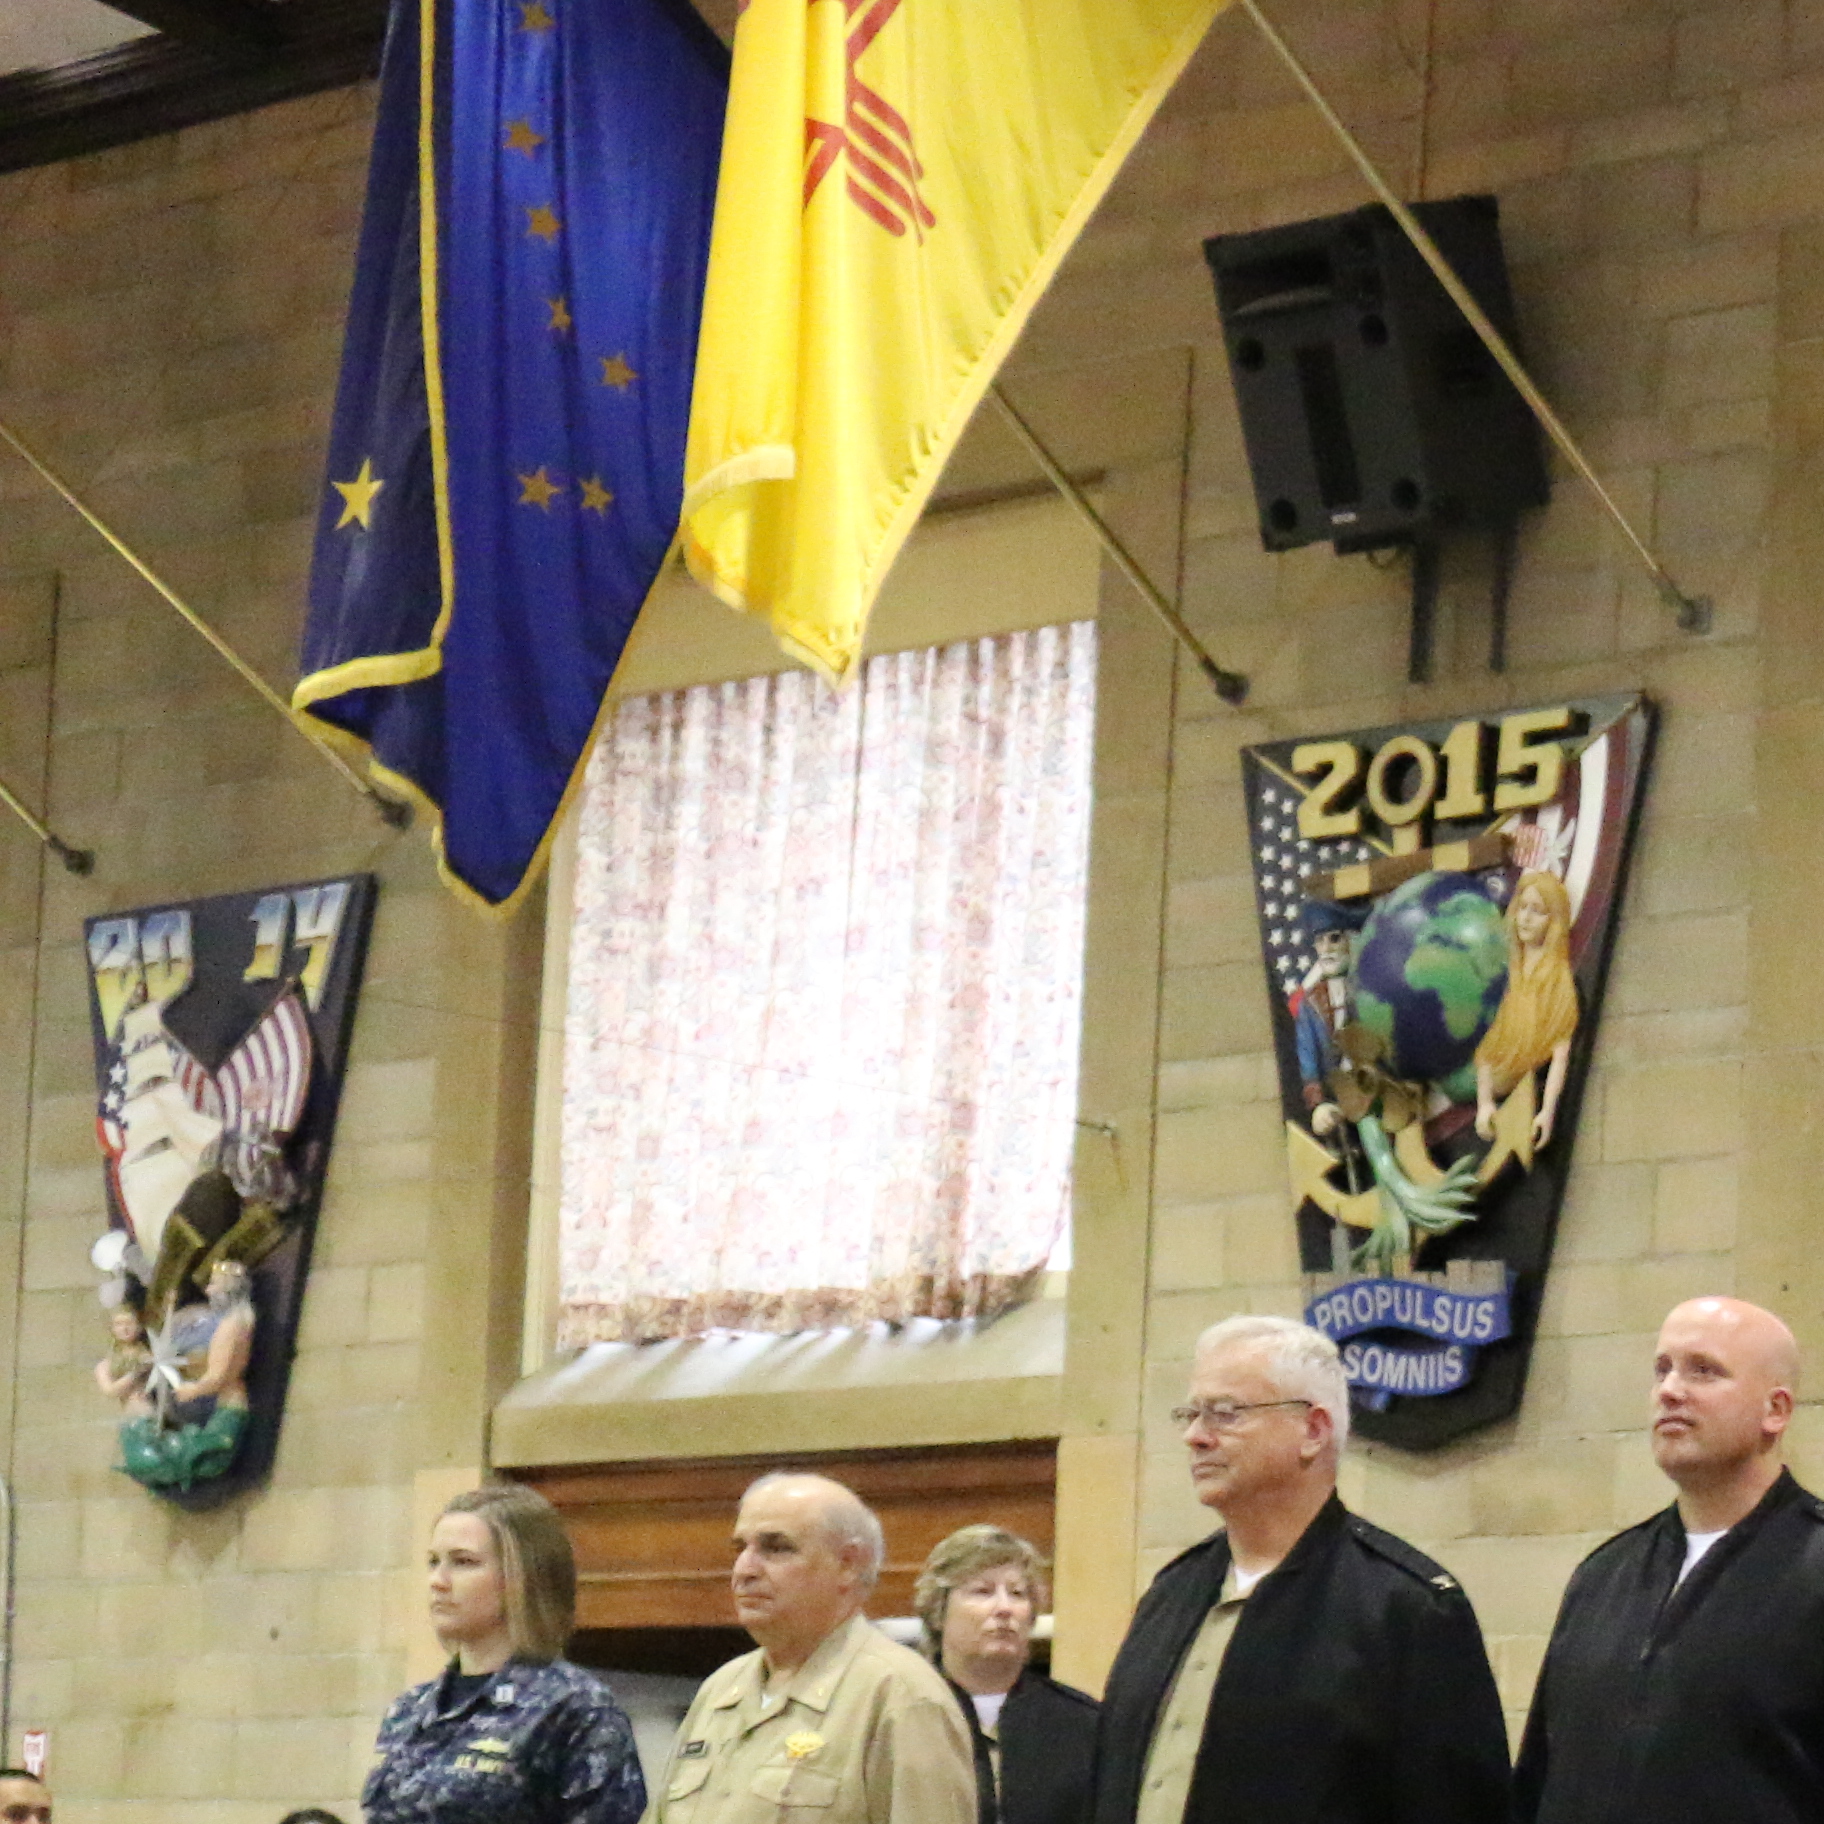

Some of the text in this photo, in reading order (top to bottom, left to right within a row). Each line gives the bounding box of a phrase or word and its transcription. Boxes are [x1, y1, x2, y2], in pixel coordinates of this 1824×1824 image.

[1291, 707, 1572, 839] 2015
[1313, 1285, 1496, 1340] PROPULSUS
[1344, 1343, 1464, 1391] SOMNIIS
